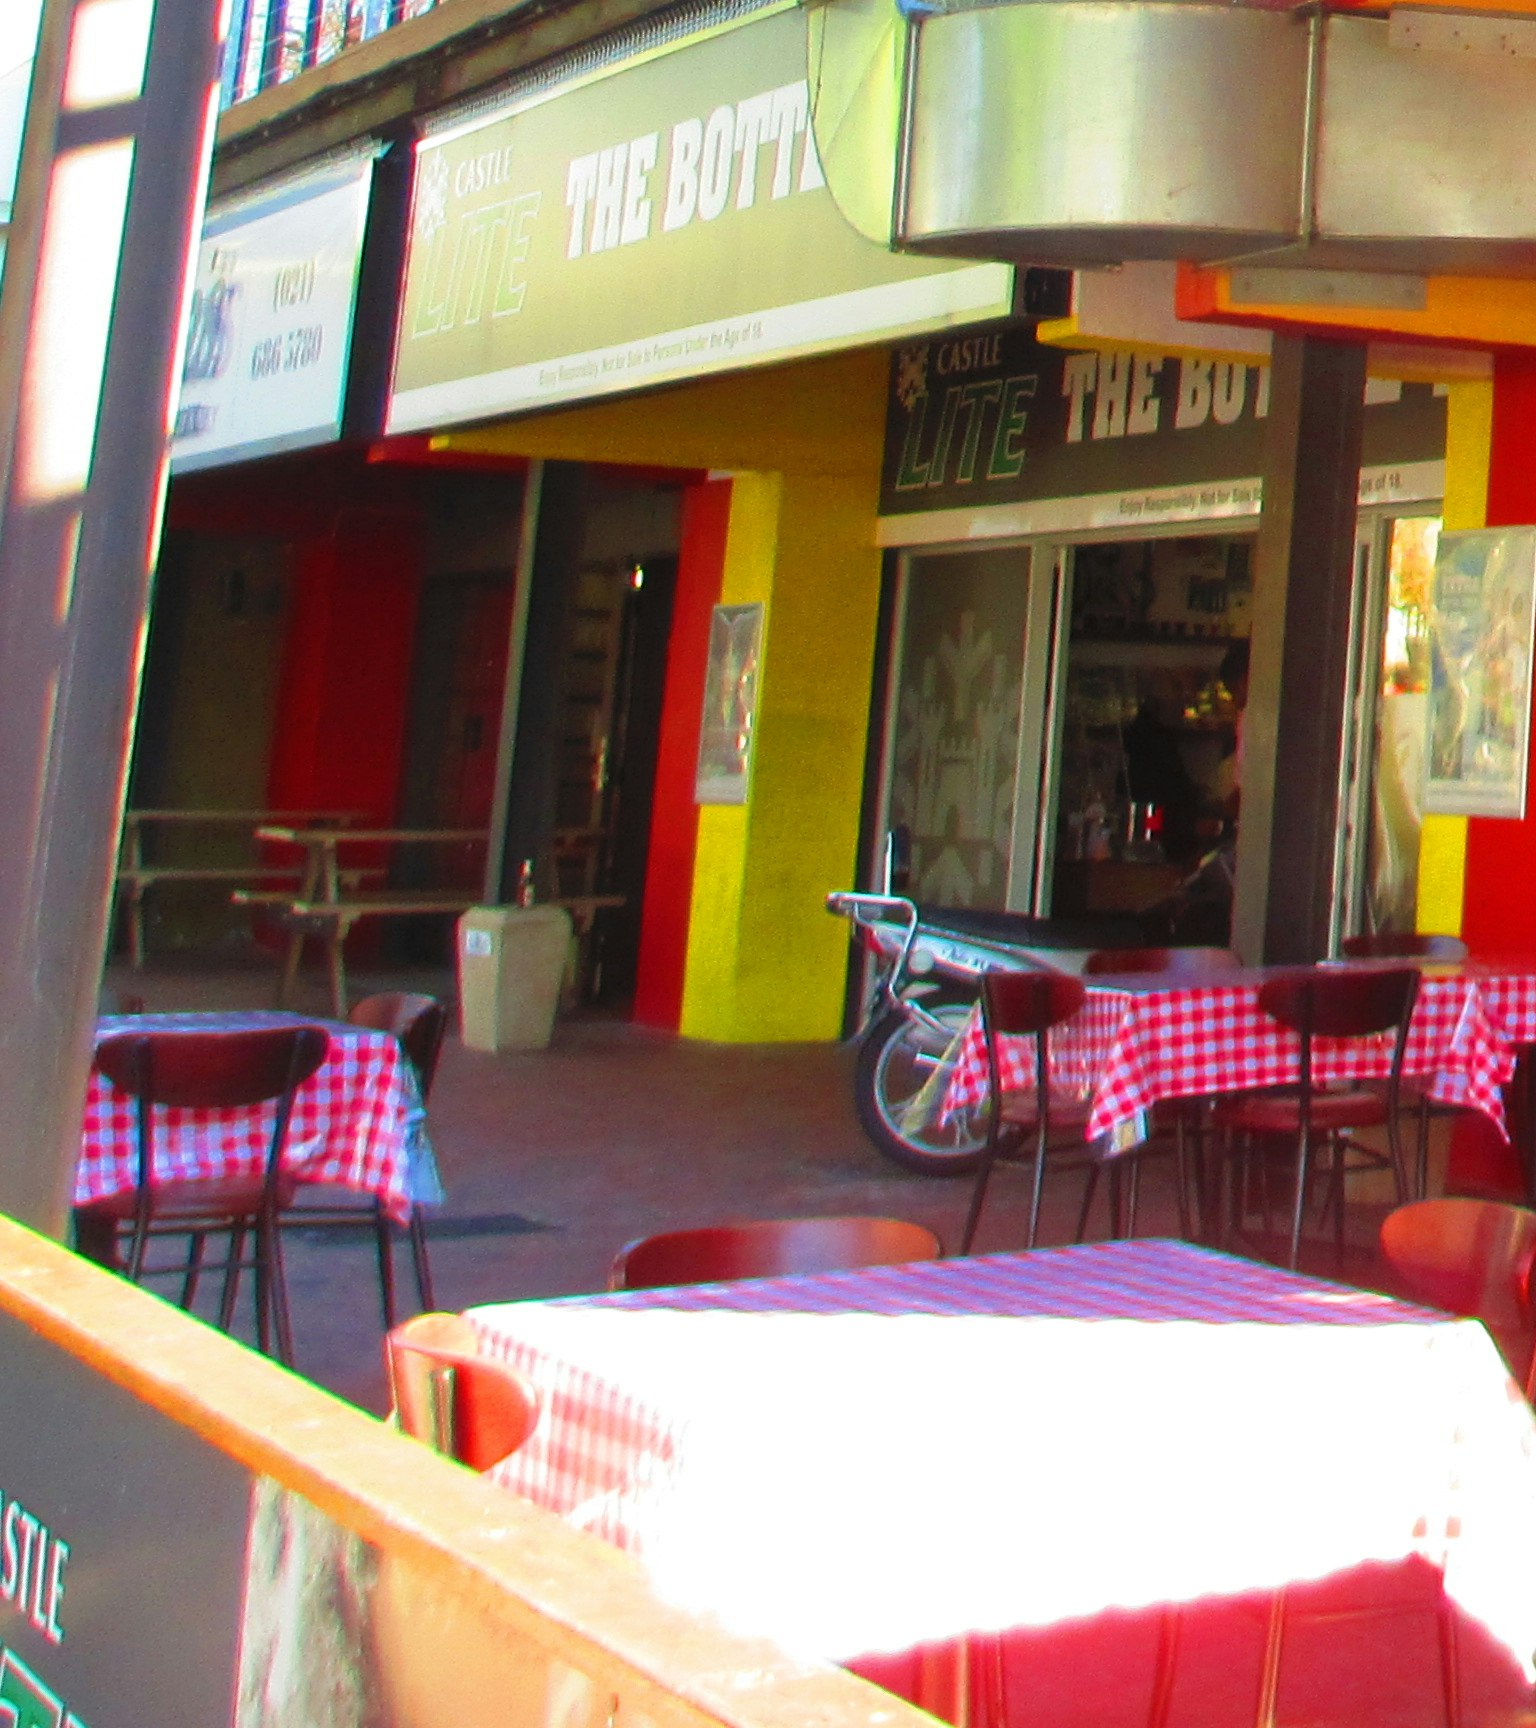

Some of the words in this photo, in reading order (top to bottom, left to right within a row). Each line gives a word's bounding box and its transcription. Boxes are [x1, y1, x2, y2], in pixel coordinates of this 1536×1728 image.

[454, 146, 514, 198] CASTLE
[566, 132, 659, 259] THE
[413, 191, 542, 339] LITE
[937, 333, 1004, 373] CASTLE
[1061, 349, 1164, 443] THE
[896, 375, 1038, 492] LITE
[0, 1489, 71, 1646] STLE
